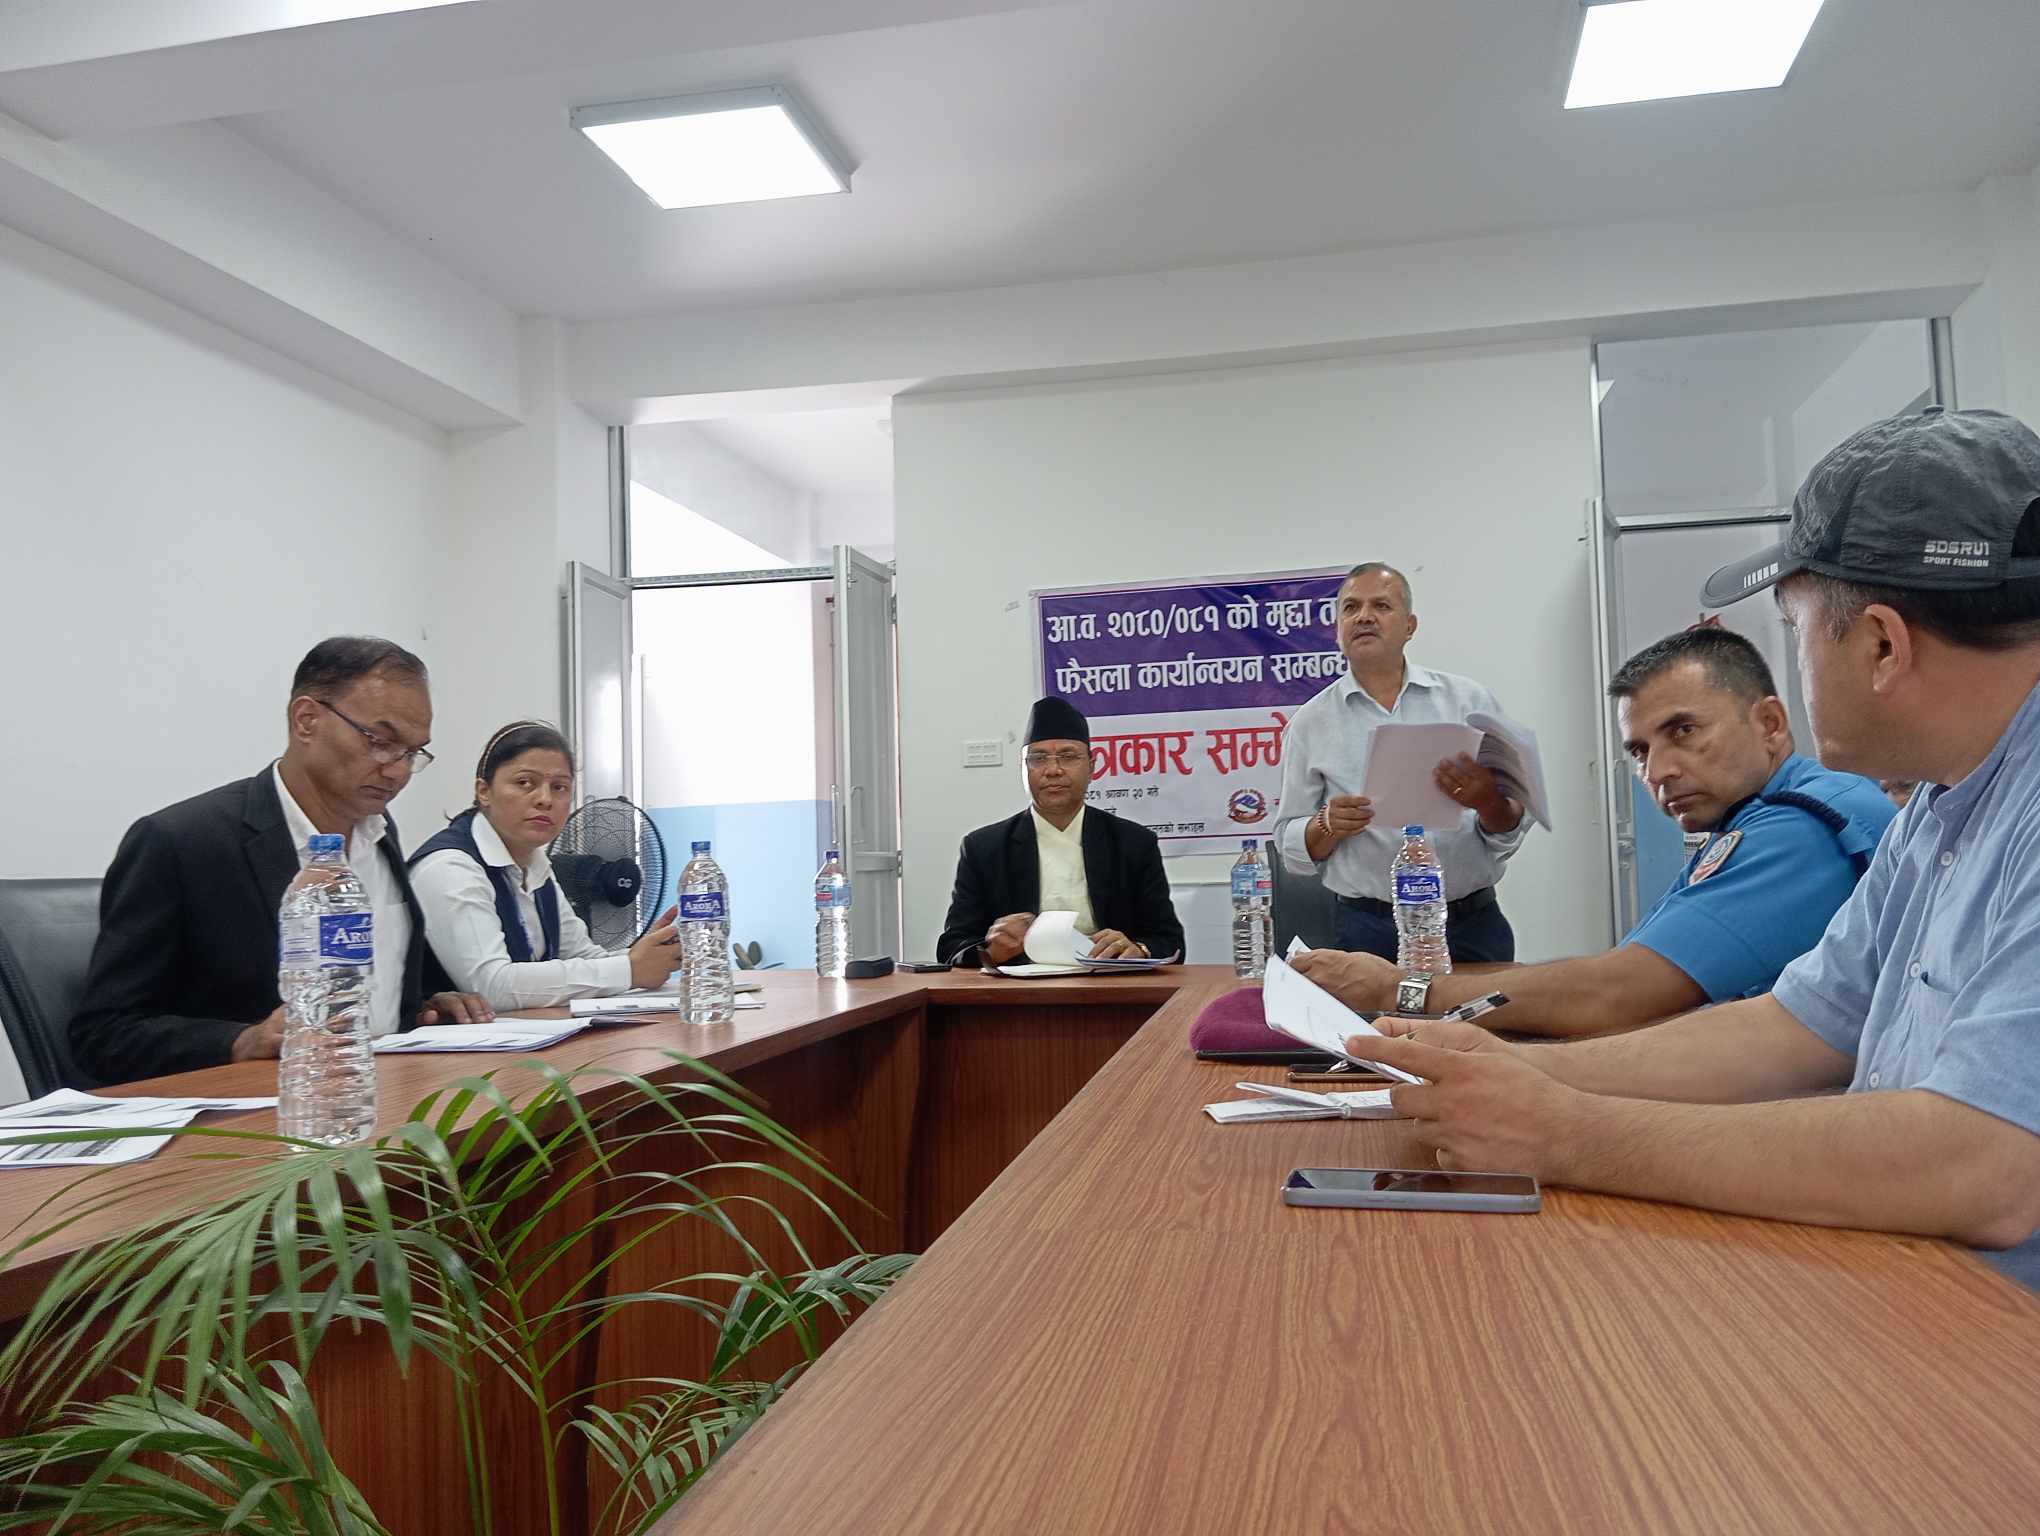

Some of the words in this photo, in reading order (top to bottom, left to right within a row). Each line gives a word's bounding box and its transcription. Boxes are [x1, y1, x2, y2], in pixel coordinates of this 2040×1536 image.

[1923, 556, 1952, 565] SPORT
[1046, 613, 1101, 643] आ.व.
[1107, 603, 1220, 639] २०८०/०८१
[1225, 594, 1260, 630] को
[1265, 599, 1313, 636] मुद्दा
[1055, 657, 1132, 695] फैसला
[1136, 651, 1265, 690] कार्यान्वयन
[1270, 651, 1347, 684] सम्बन्ध
[1089, 730, 1194, 781] त्रकार
